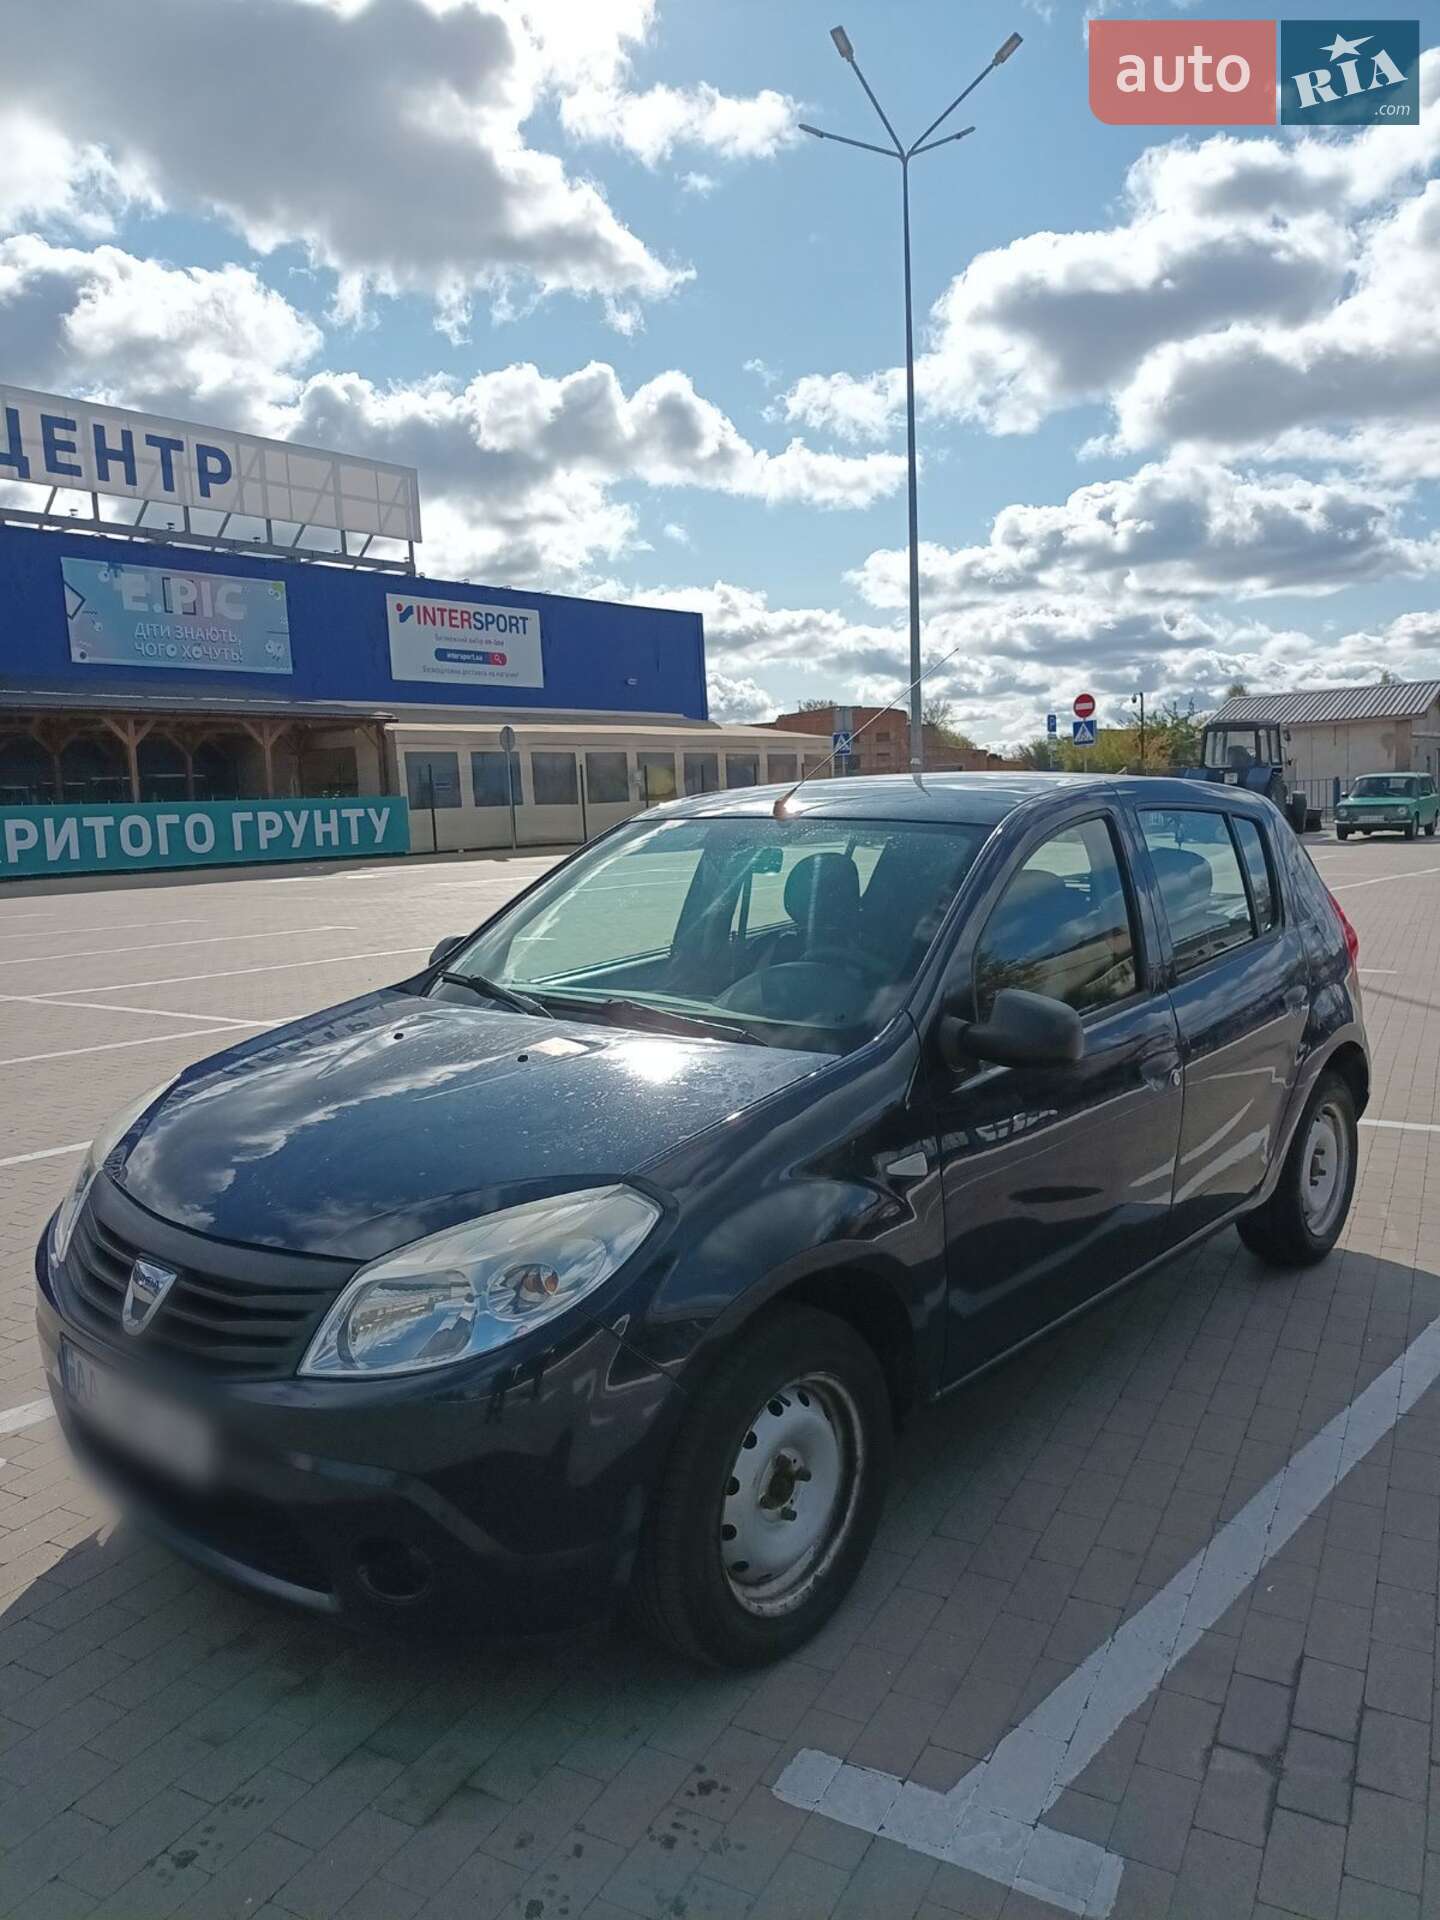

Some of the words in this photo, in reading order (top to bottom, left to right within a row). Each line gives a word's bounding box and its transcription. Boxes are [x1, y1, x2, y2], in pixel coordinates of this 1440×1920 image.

[135, 622, 170, 640] ДІТИ
[416, 605, 529, 635] INTERSPORT
[134, 641, 177, 658] ЧОГО
[0, 813, 215, 864] РИТОГО
[231, 807, 391, 851] ГРУНТУ
